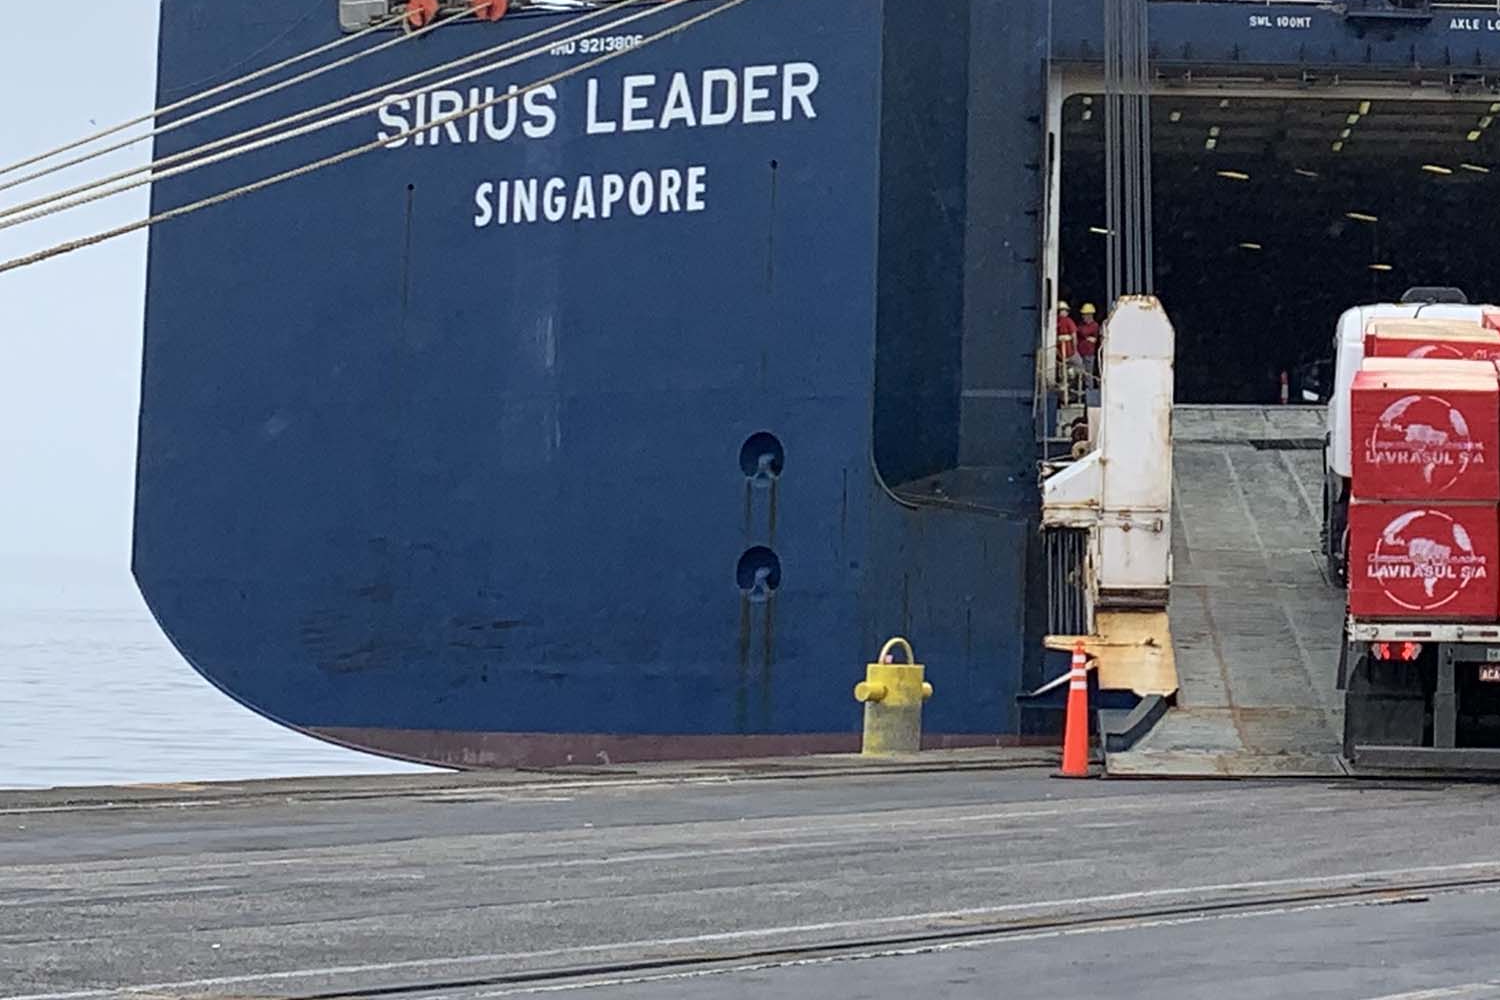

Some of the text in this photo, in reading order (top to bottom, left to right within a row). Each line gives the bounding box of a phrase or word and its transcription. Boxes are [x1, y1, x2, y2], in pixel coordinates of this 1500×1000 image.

[1249, 15, 1273, 27] SWL
[1450, 18, 1480, 31] AXLE
[377, 62, 819, 149] SIRIUS LEADER
[474, 166, 706, 227] SINGAPORE
[1367, 564, 1457, 579] LAVRASUL
